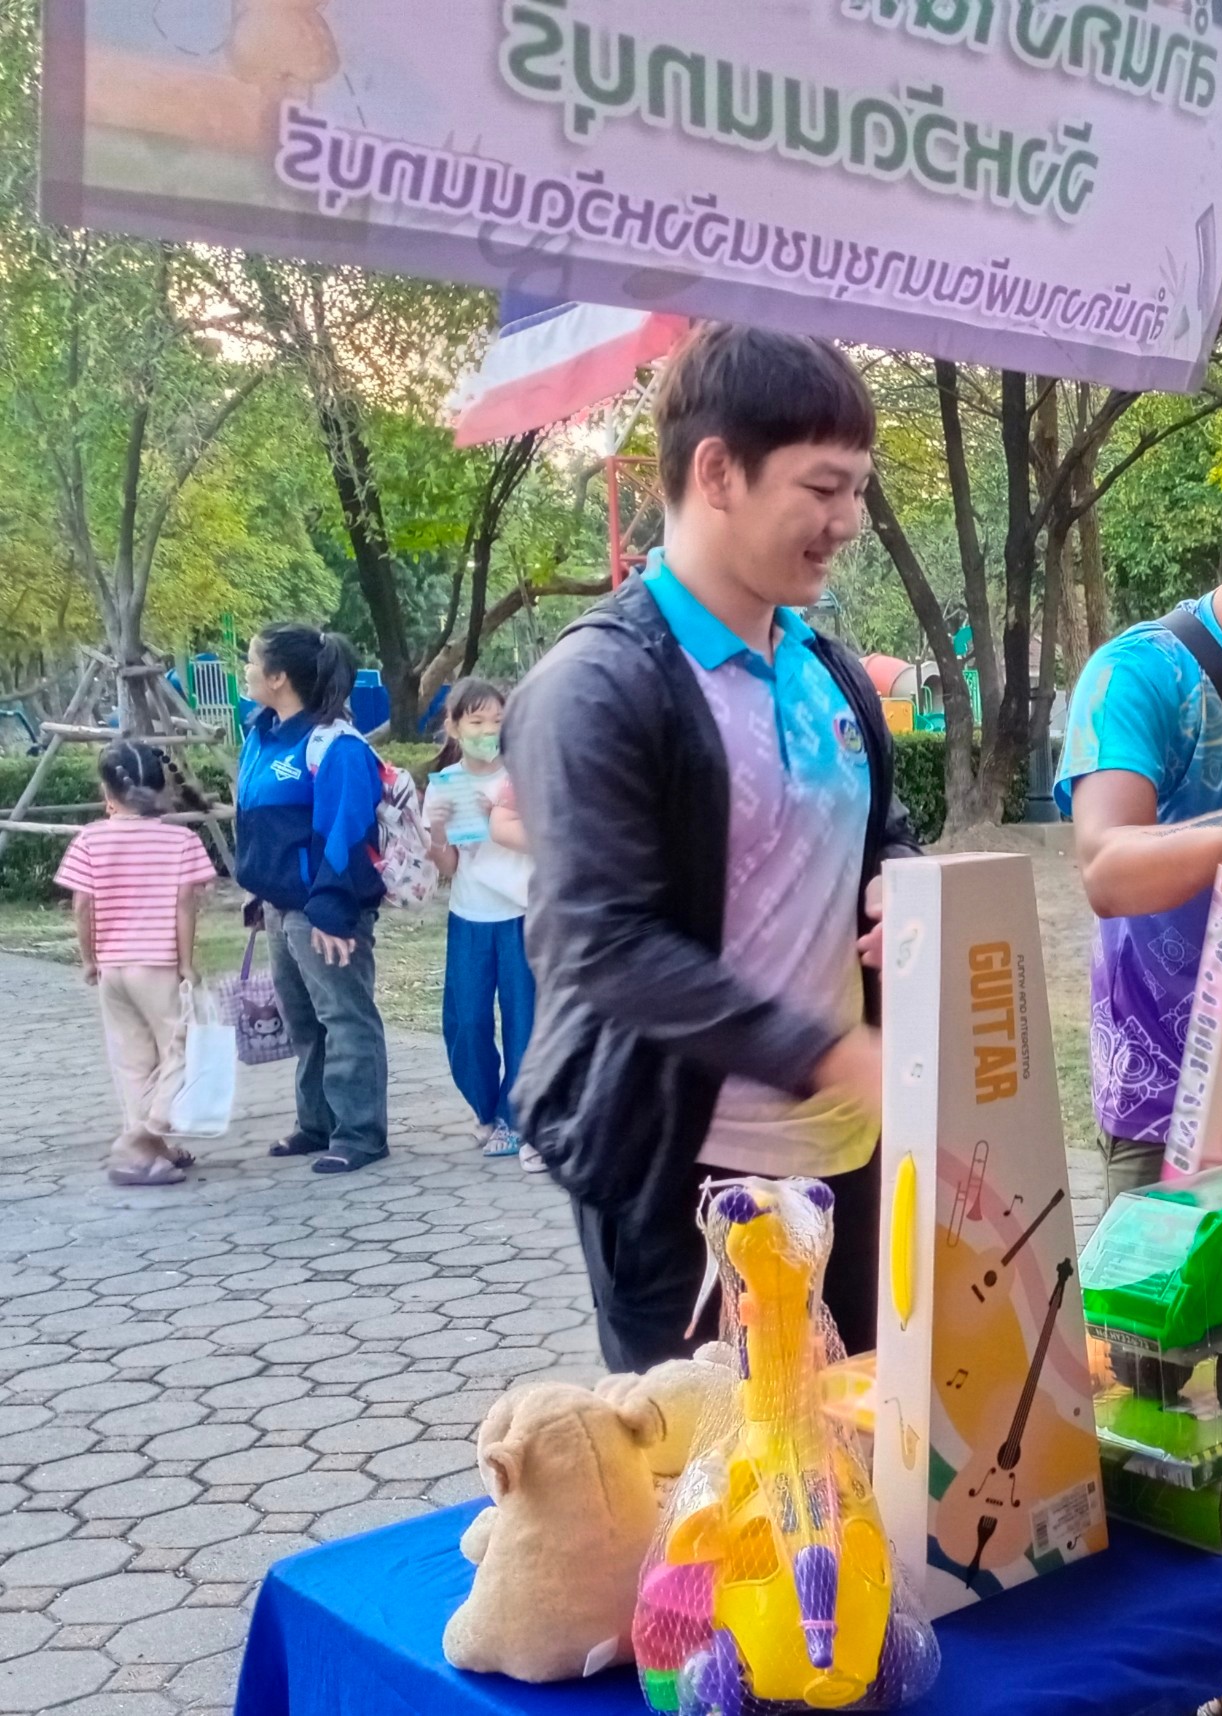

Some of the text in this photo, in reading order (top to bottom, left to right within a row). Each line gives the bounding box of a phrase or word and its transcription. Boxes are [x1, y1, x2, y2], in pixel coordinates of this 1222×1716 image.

[968, 940, 1019, 1105] GUITAR
[1017, 954, 1031, 1080] FUNNY AND INTERESTING
